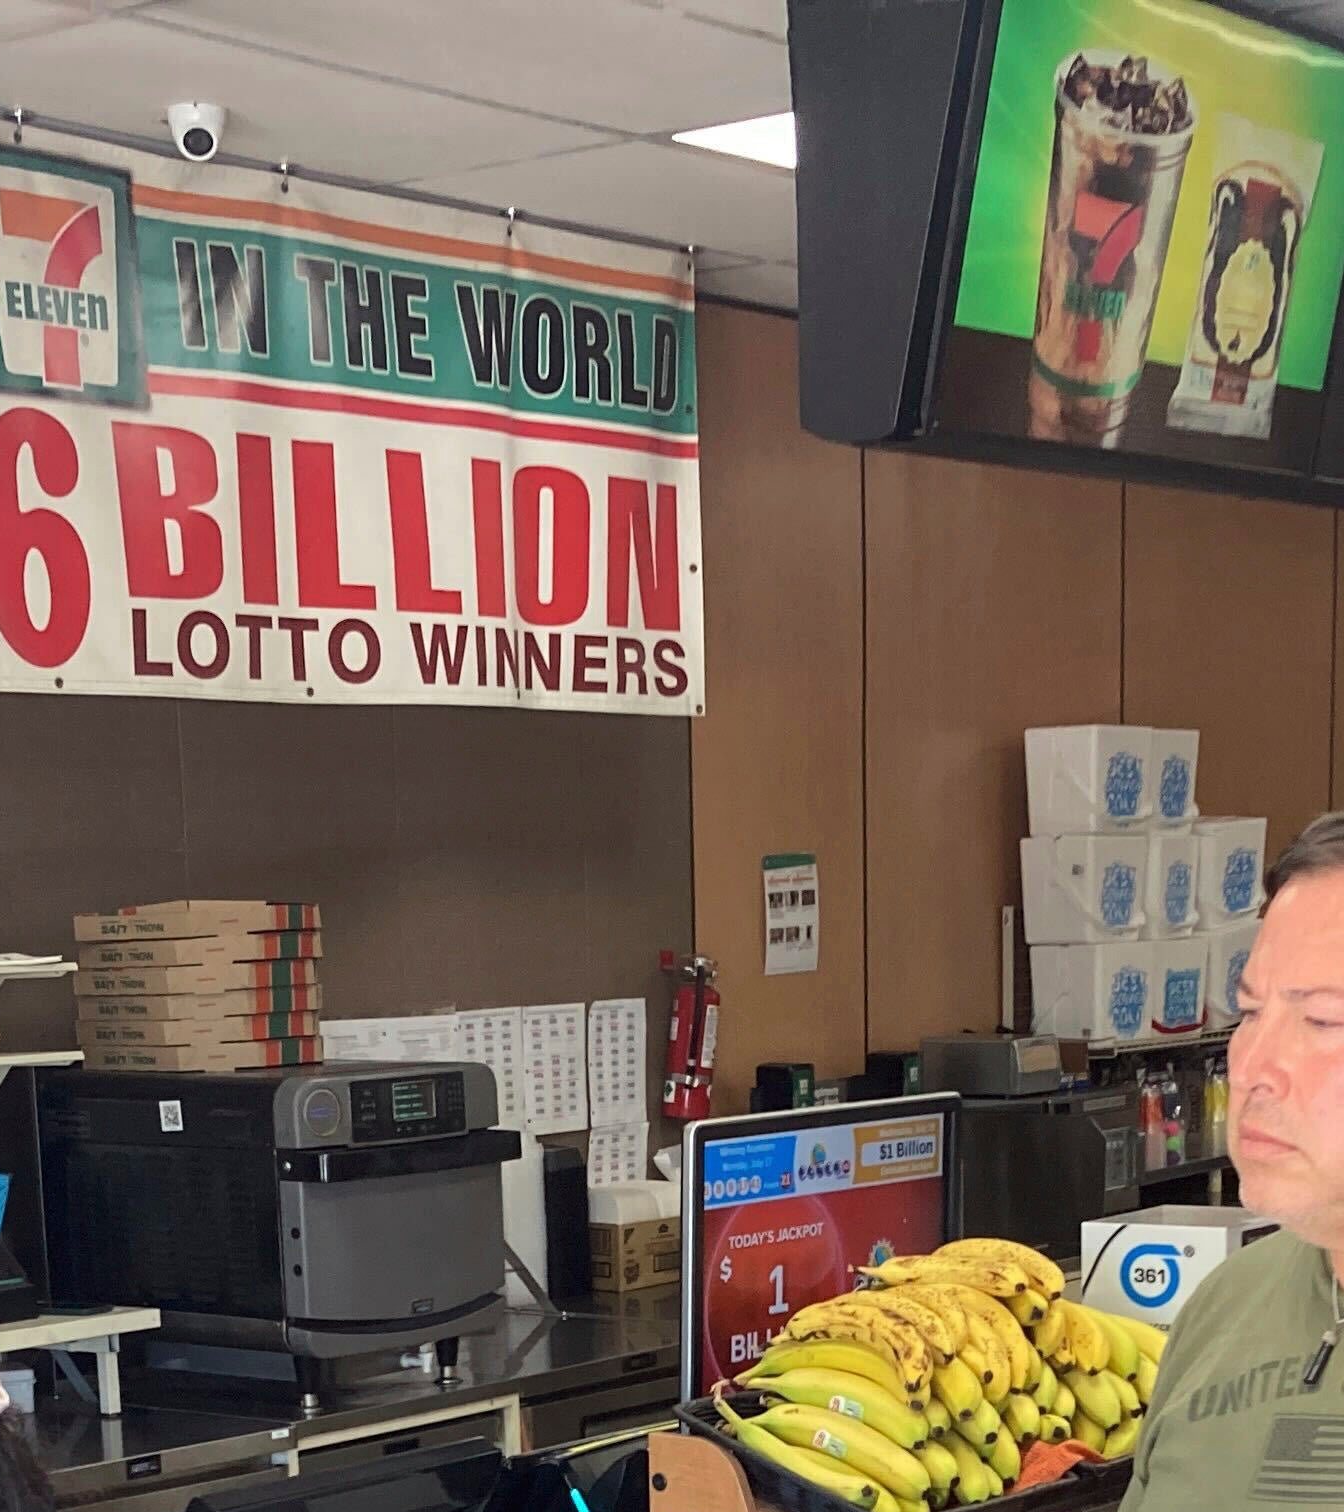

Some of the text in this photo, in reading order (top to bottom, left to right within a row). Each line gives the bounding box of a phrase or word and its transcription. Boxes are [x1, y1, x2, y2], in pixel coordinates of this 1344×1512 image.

[174, 239, 678, 415] IN THE WORLD
[111, 421, 681, 632] BILLION
[132, 609, 689, 698] LOTTO WINNERS
[896, 1139, 934, 1157] Billion
[728, 1222, 824, 1250] TODAY'S JACKPOT
[719, 1255, 733, 1283] $
[768, 1264, 789, 1315] 1
[1134, 1268, 1166, 1284] 361
[1186, 1353, 1328, 1424] UNITED
